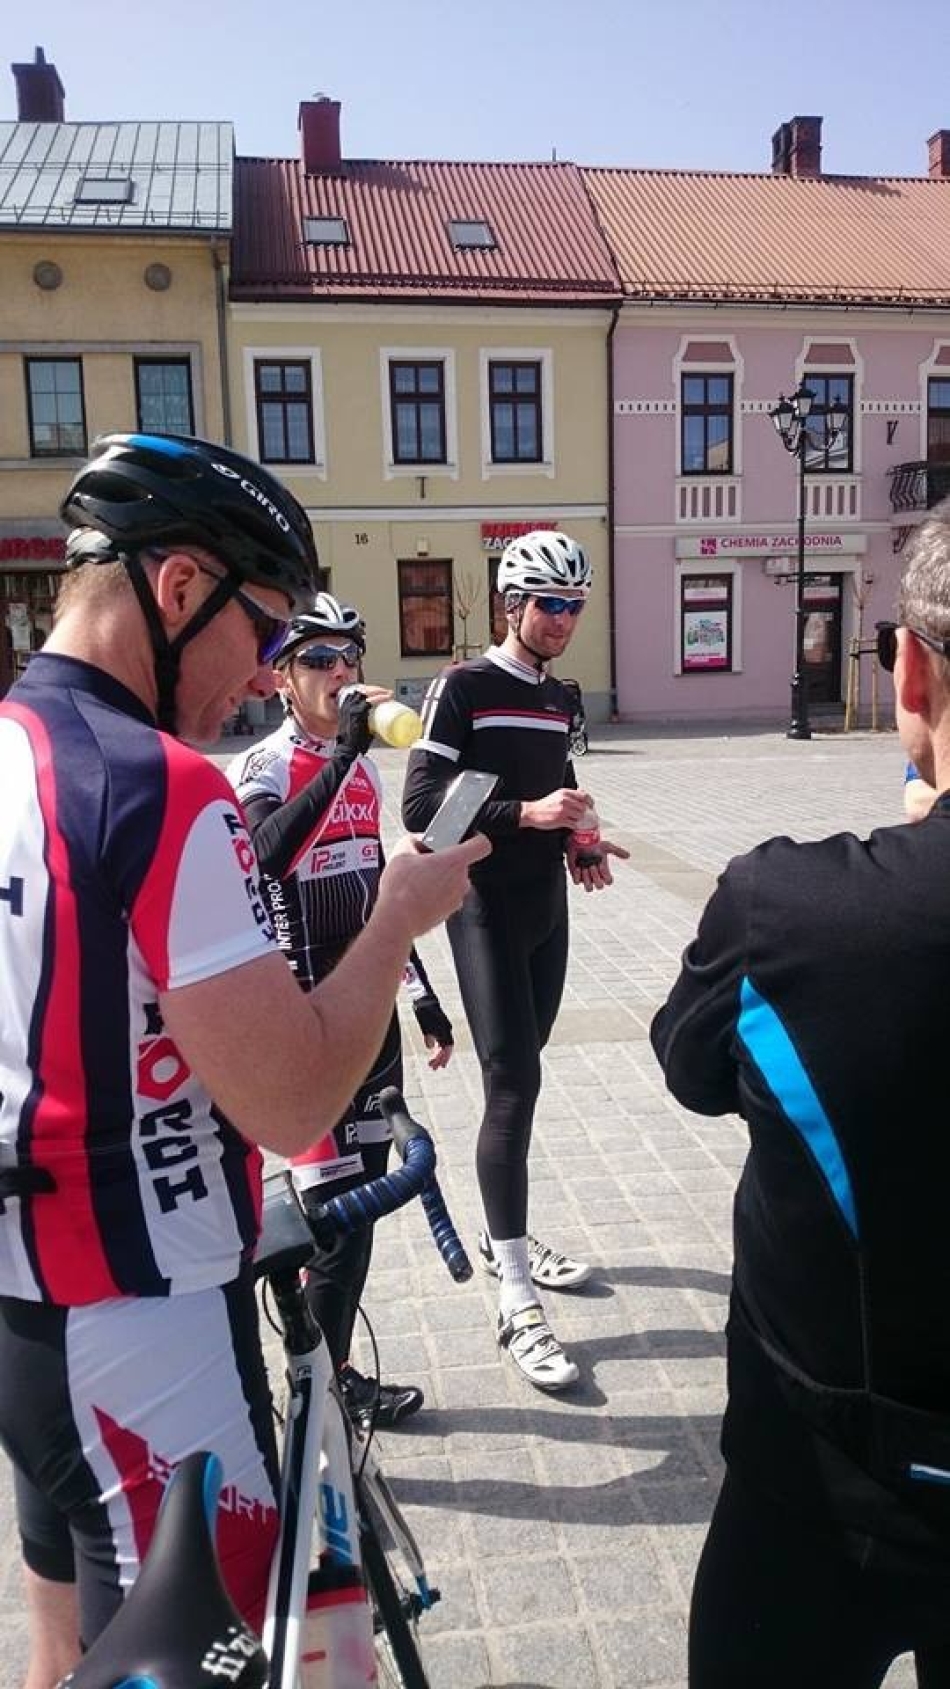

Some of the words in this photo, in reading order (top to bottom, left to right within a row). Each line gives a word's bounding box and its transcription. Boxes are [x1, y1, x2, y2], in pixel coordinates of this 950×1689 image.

[241, 480, 290, 532] GIRO
[355, 532, 369, 545] 16
[720, 538, 768, 548] CHEMIA
[274, 911, 292, 950] INTER
